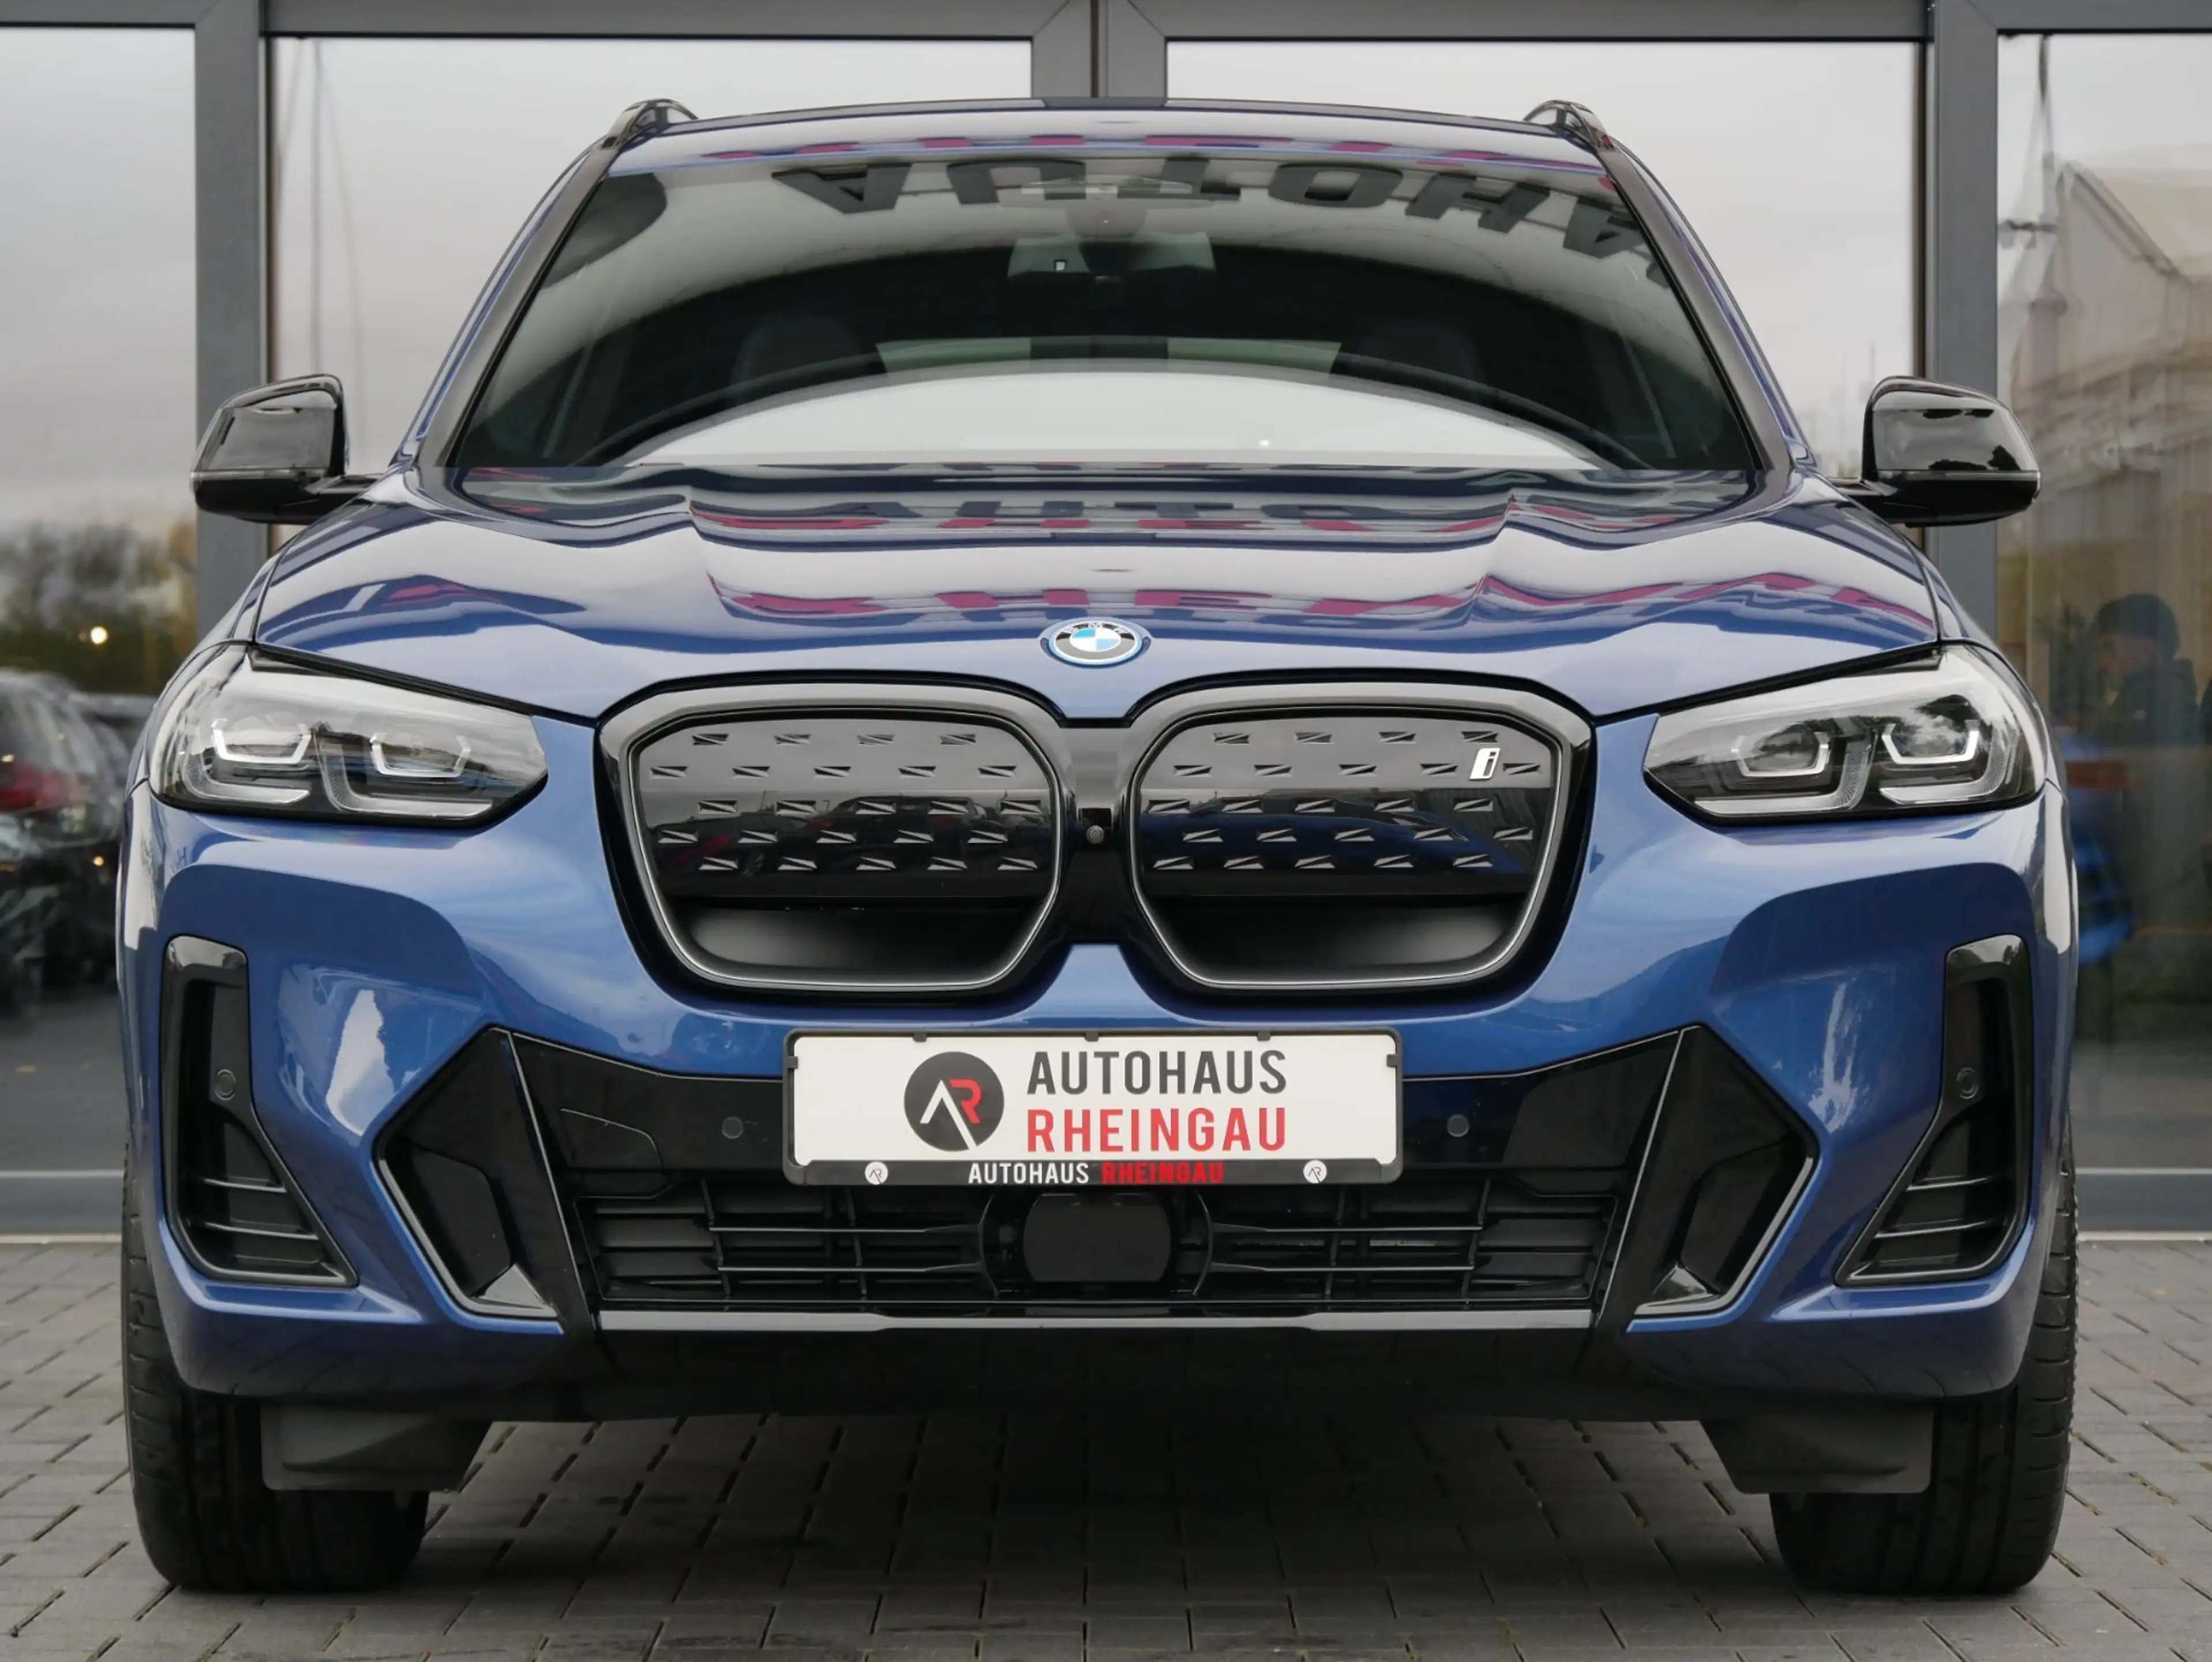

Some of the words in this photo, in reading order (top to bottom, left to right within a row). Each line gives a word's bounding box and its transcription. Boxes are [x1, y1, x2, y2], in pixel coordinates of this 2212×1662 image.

[1061, 622, 1131, 634] BMW
[1027, 1050, 1287, 1094] AUTOHAUS
[1027, 1107, 1285, 1152] RHEINGAU
[968, 1162, 1089, 1184] AUTOHAUS
[1101, 1161, 1224, 1184] RHEINGAU
